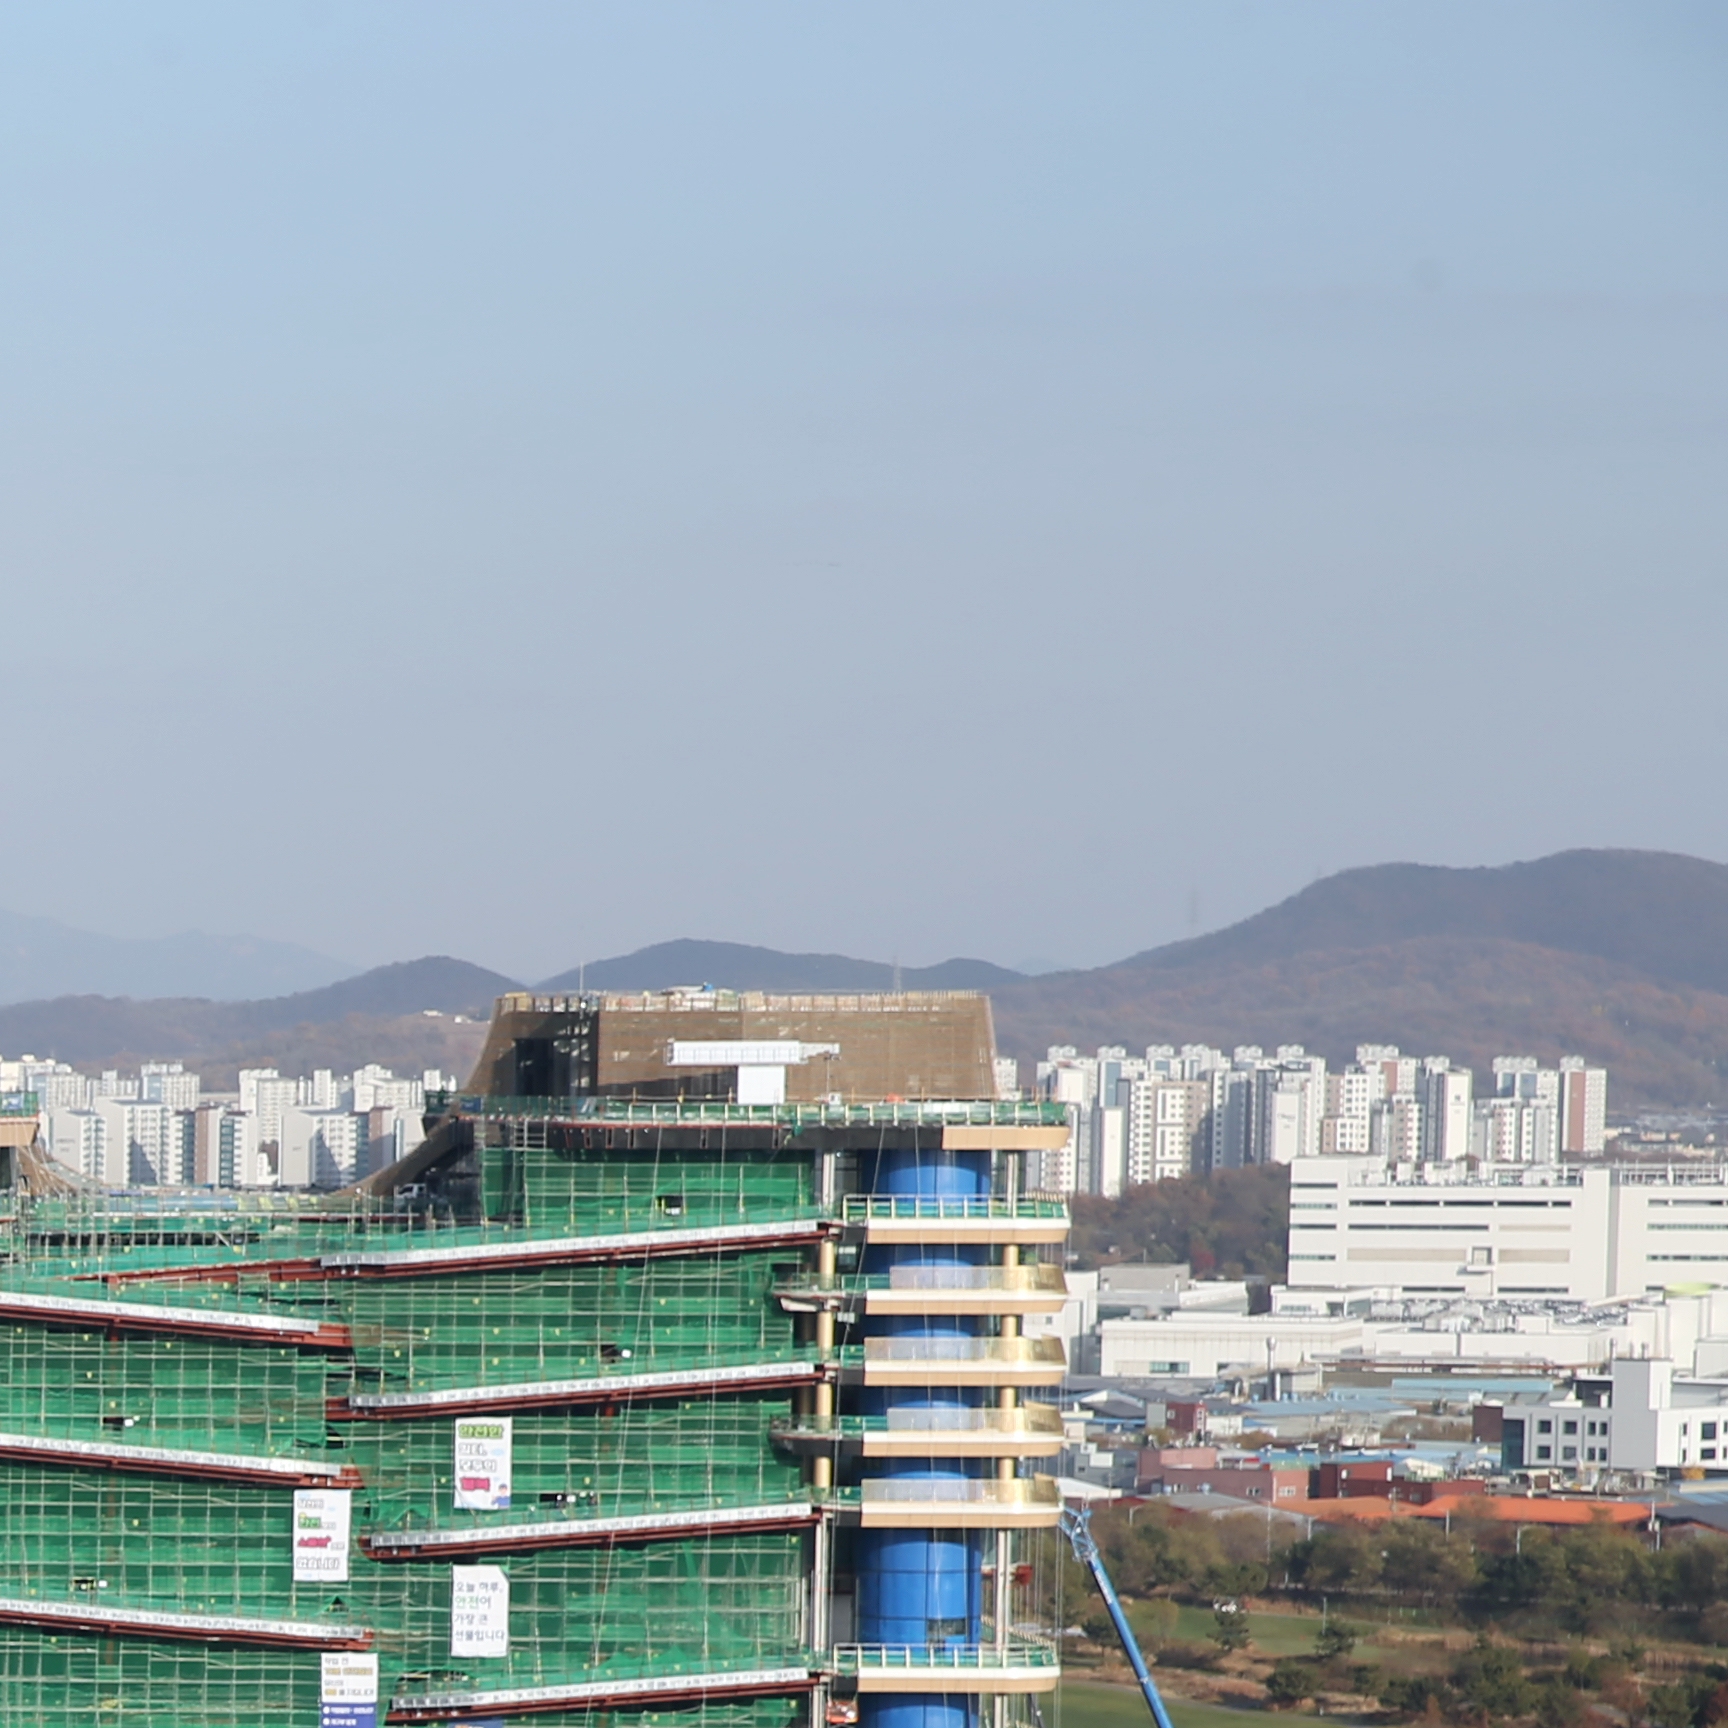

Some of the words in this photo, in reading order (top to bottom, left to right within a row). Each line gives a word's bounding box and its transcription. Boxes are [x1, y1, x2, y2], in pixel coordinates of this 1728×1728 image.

[455, 1582, 474, 1593] 오늘
[455, 1595, 491, 1609] 안전이
[454, 1614, 475, 1625] 가장
[455, 1630, 505, 1641] 선물입니다
